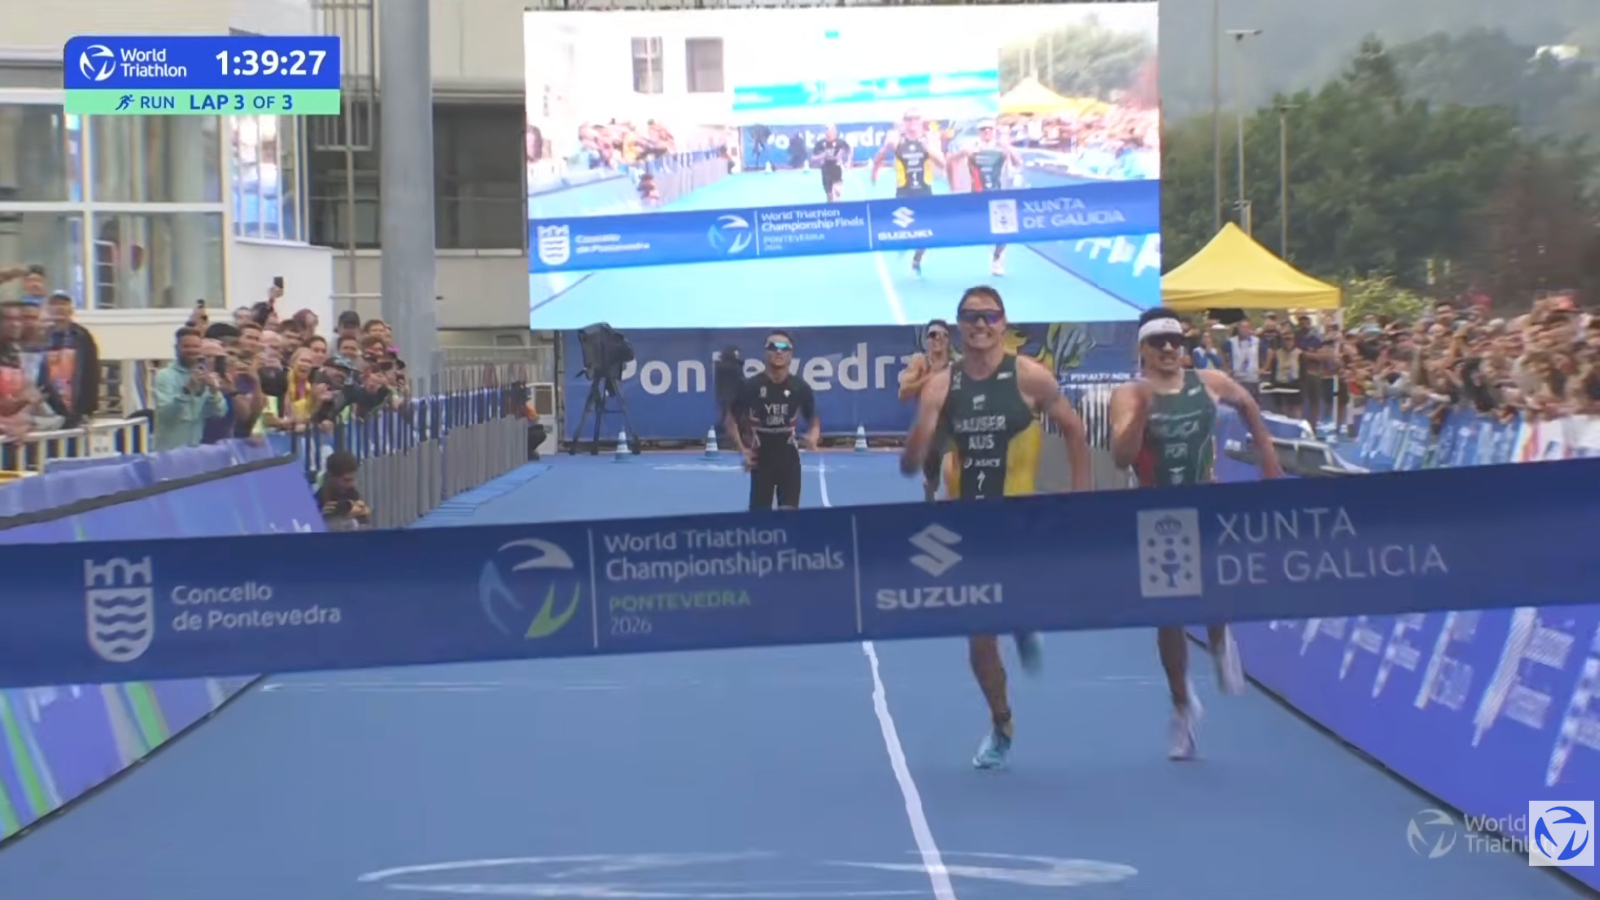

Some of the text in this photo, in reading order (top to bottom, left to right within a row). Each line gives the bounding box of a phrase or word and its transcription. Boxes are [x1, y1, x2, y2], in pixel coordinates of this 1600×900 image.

[760, 208, 840, 222] World Triathlon
[1023, 197, 1085, 213] XUNTA
[762, 216, 865, 233] Championship Finals
[1023, 210, 1125, 230] DE GALICIA
[878, 229, 933, 241] SUZUKI
[764, 403, 789, 415] YEE
[969, 434, 994, 450] AUS
[1216, 507, 1356, 544] XUNTA
[605, 527, 787, 553] World Triathlon
[607, 546, 844, 583] Championship Finals
[1217, 544, 1448, 585] DE GALICIA
[171, 581, 273, 605] Concello
[610, 590, 752, 613] PONTEVEDRA
[876, 584, 1002, 610] SUZUKI
[172, 605, 342, 631] de Pontevedra
[610, 616, 652, 636] 2026
